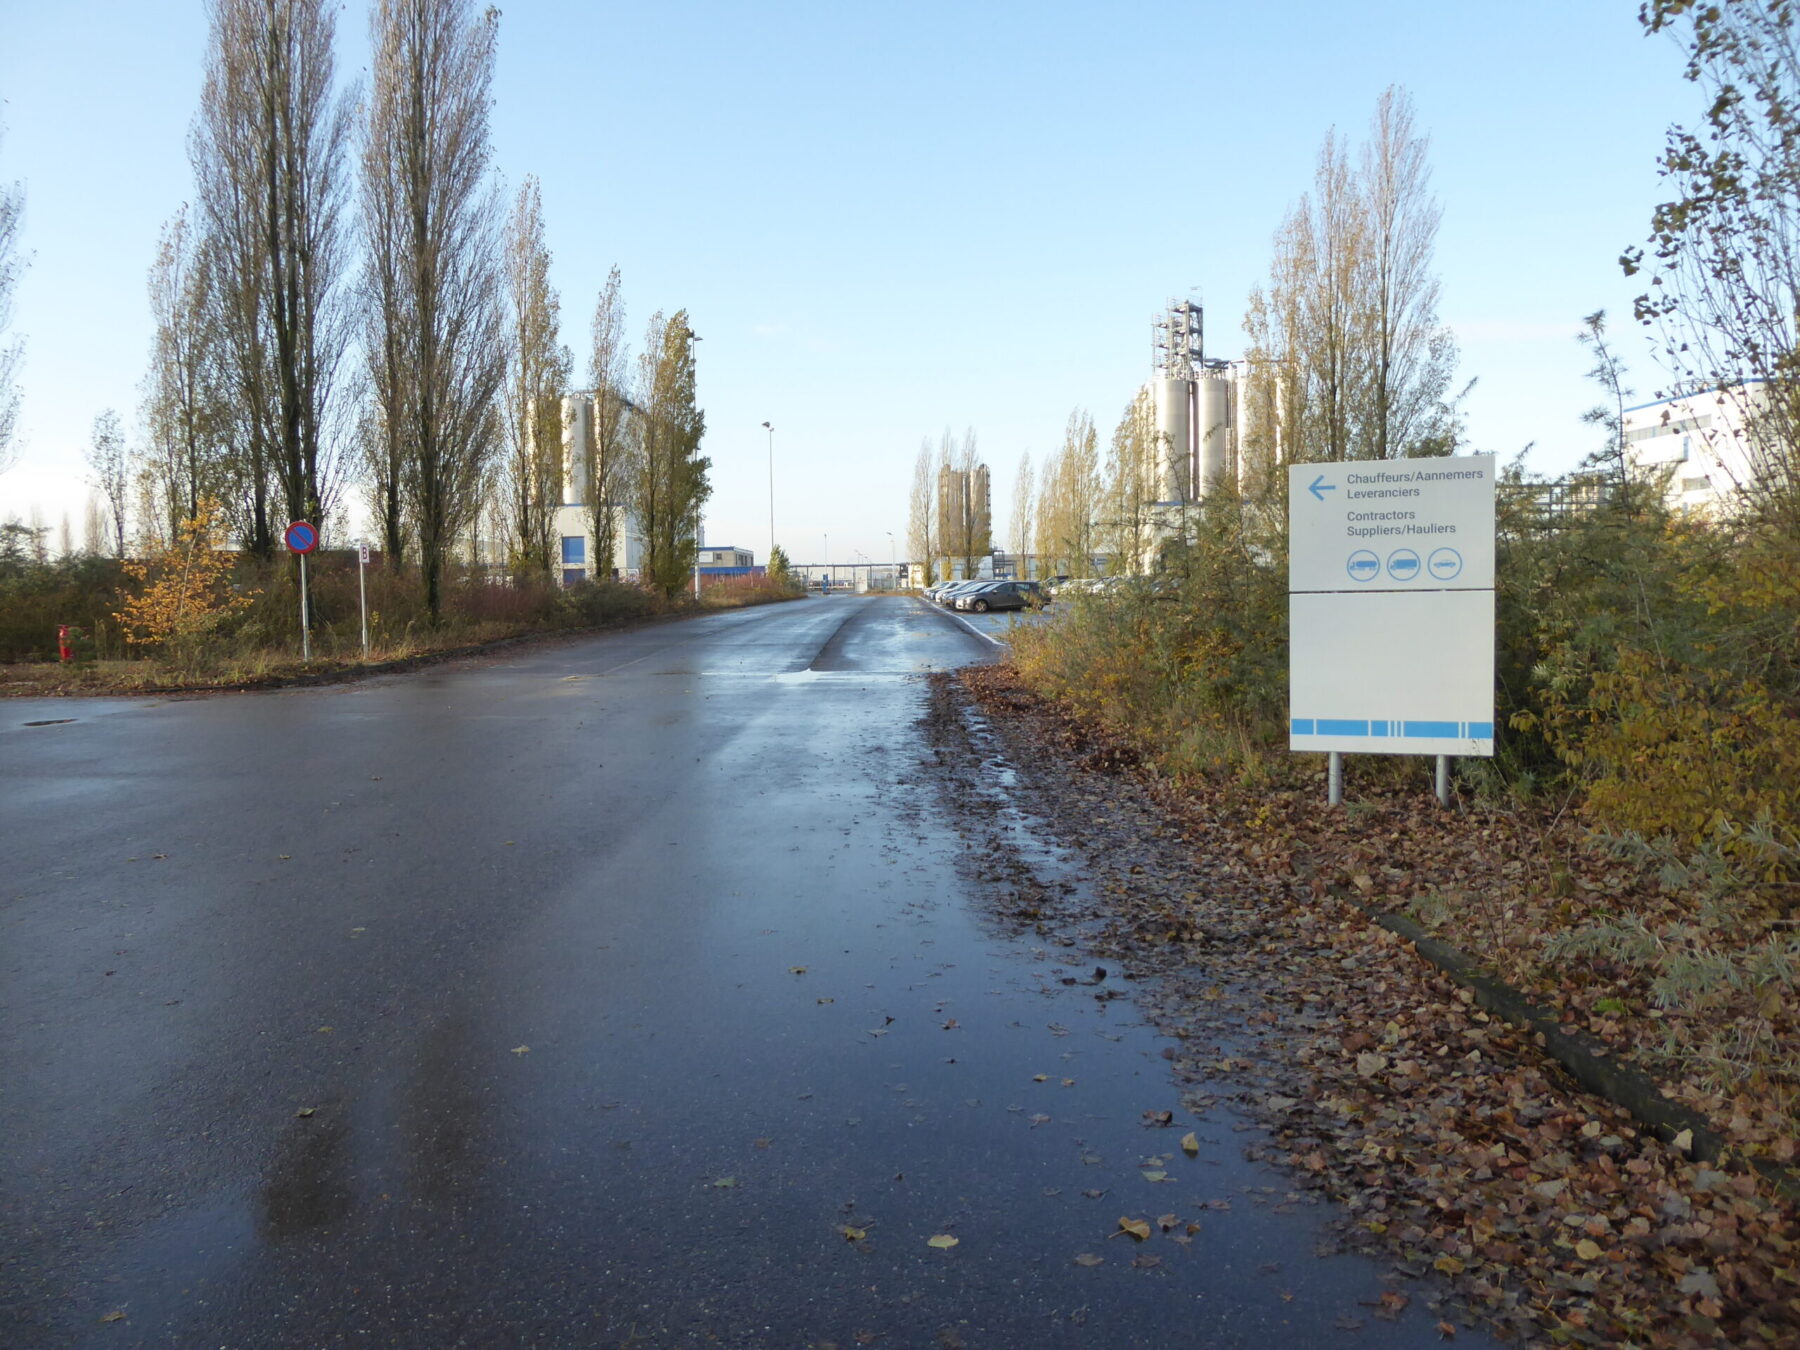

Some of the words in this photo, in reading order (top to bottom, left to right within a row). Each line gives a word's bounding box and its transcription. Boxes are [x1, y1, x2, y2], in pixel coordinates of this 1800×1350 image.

[1347, 470, 1484, 484] Chauffeurs/Aannemers
[1347, 487, 1420, 499] Leveranciers
[1347, 510, 1416, 521] Contractors
[1347, 523, 1456, 538] Suppliers/Hauliers
